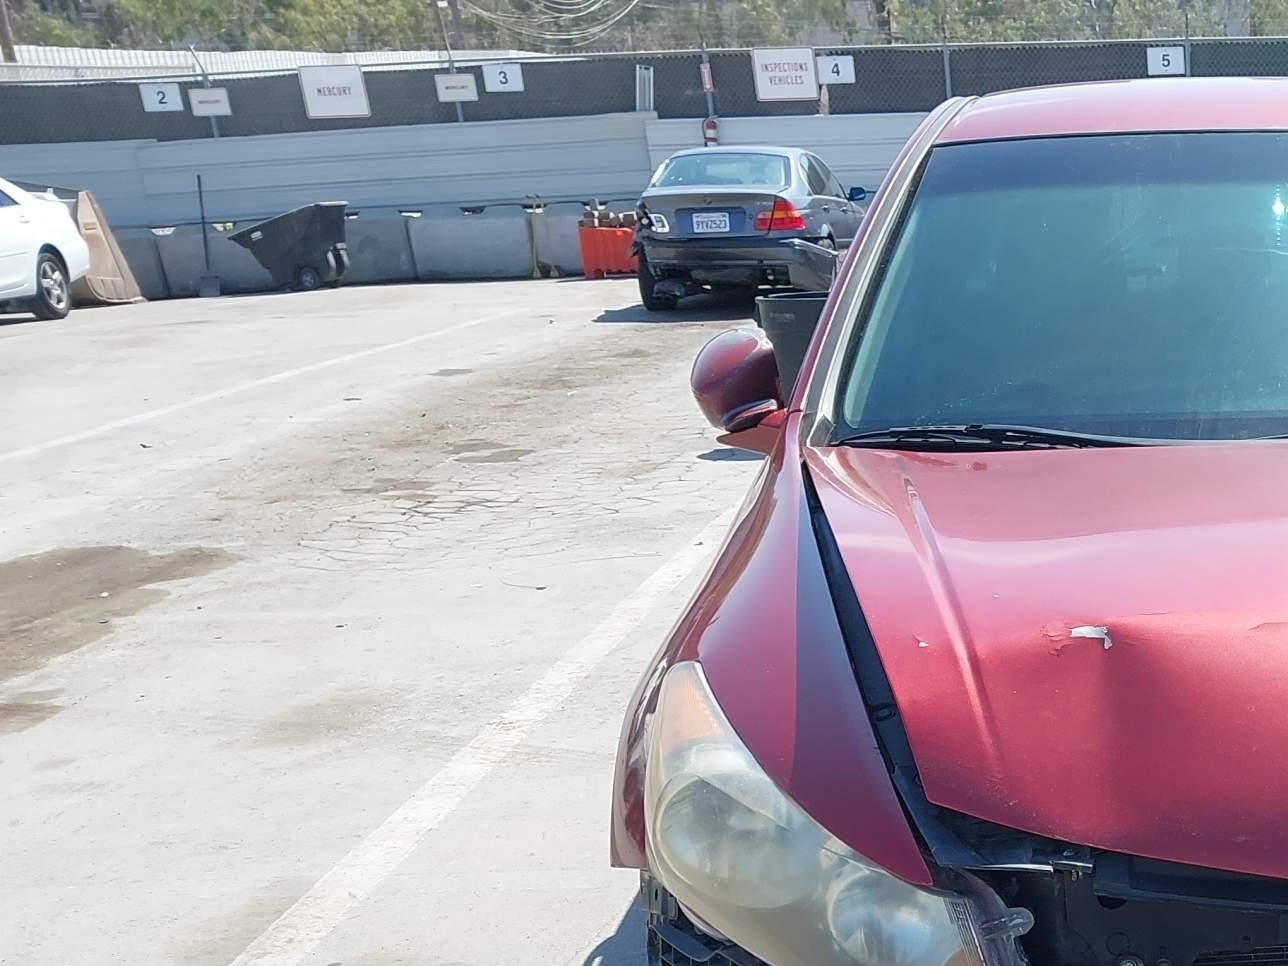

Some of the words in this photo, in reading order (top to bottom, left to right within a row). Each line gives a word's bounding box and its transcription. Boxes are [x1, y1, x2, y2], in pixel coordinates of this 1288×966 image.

[760, 62, 808, 73] INSPECTIONS
[1161, 53, 1171, 68] 5
[831, 62, 841, 77] 4
[498, 70, 509, 85] 3
[768, 75, 804, 86] VEHICLES
[156, 90, 168, 105] 2
[316, 86, 352, 97] MERCURY
